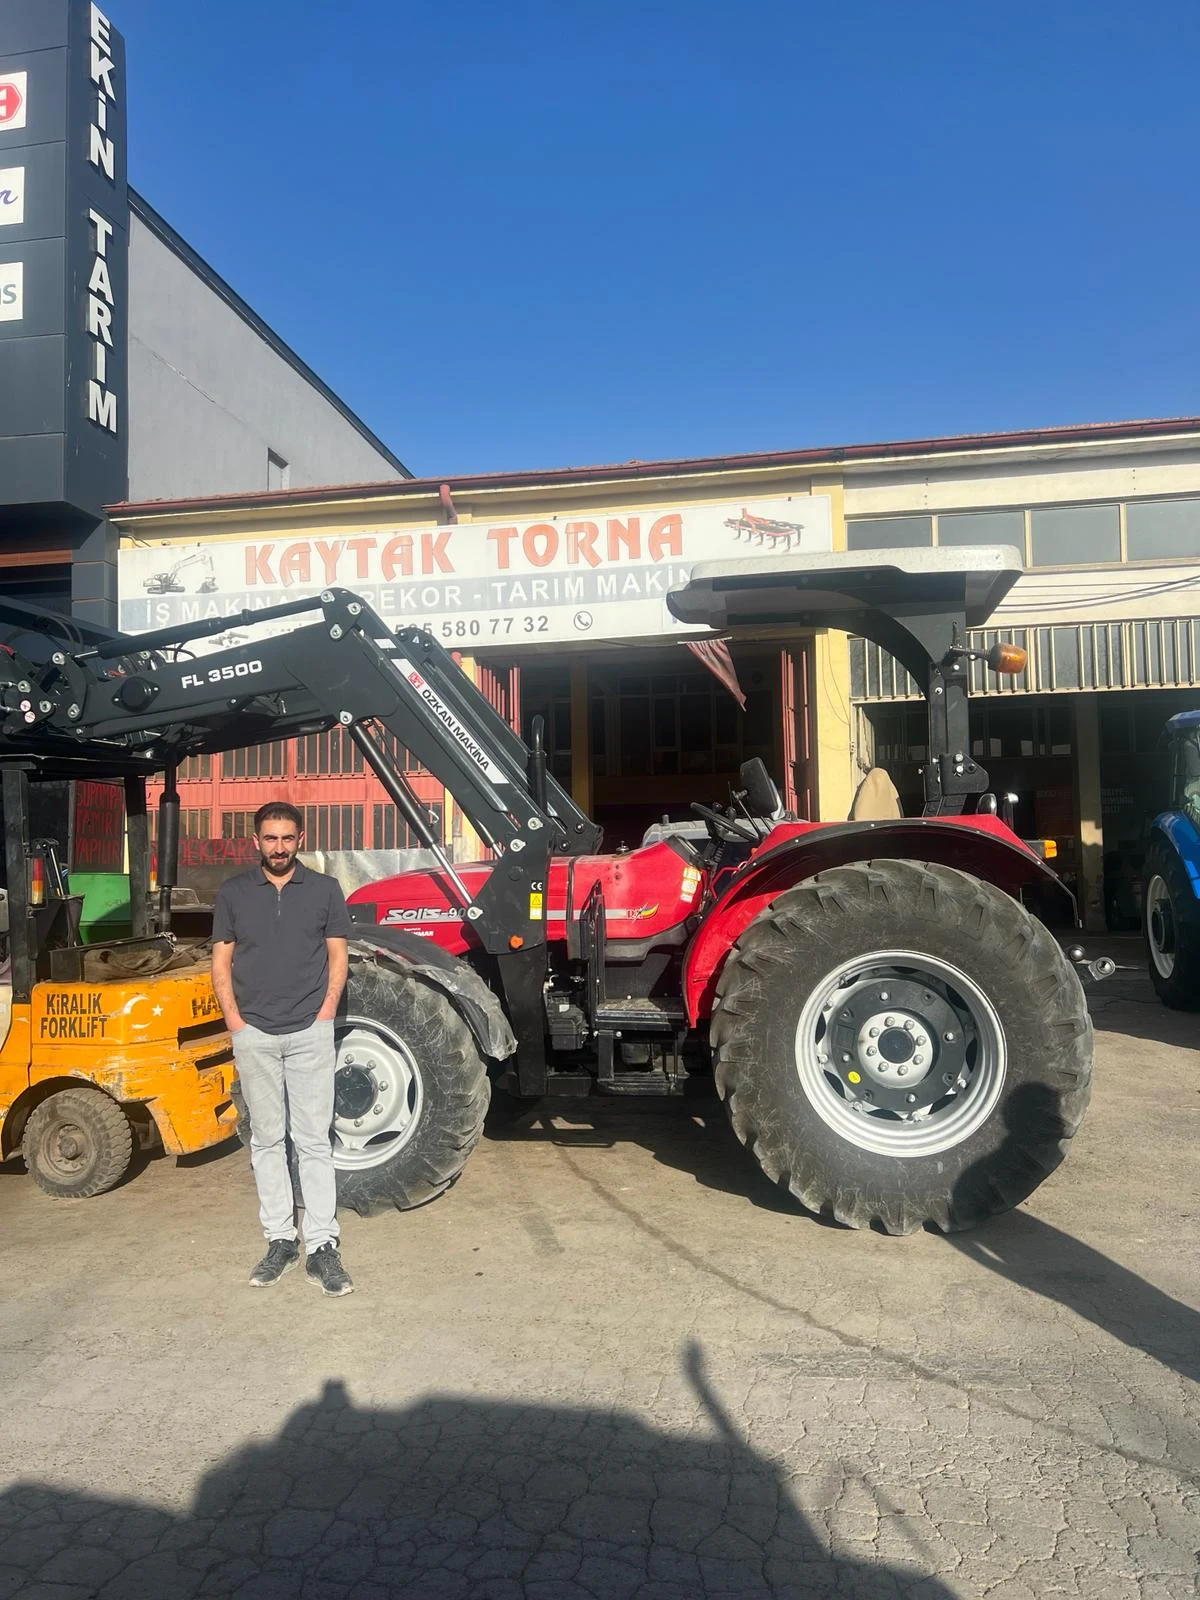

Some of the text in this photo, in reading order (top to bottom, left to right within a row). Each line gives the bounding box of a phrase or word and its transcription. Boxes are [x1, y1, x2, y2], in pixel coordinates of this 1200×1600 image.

[89, 207, 118, 434] TARIM
[245, 513, 683, 587] KAYTAK TORNA
[492, 576, 584, 602] TARIM
[442, 619, 480, 638] 580
[489, 617, 514, 635] 77
[523, 615, 549, 633] 32
[181, 659, 263, 689] FL 3500
[453, 726, 490, 771] MAKİNA
[531, 882, 543, 891] CE
